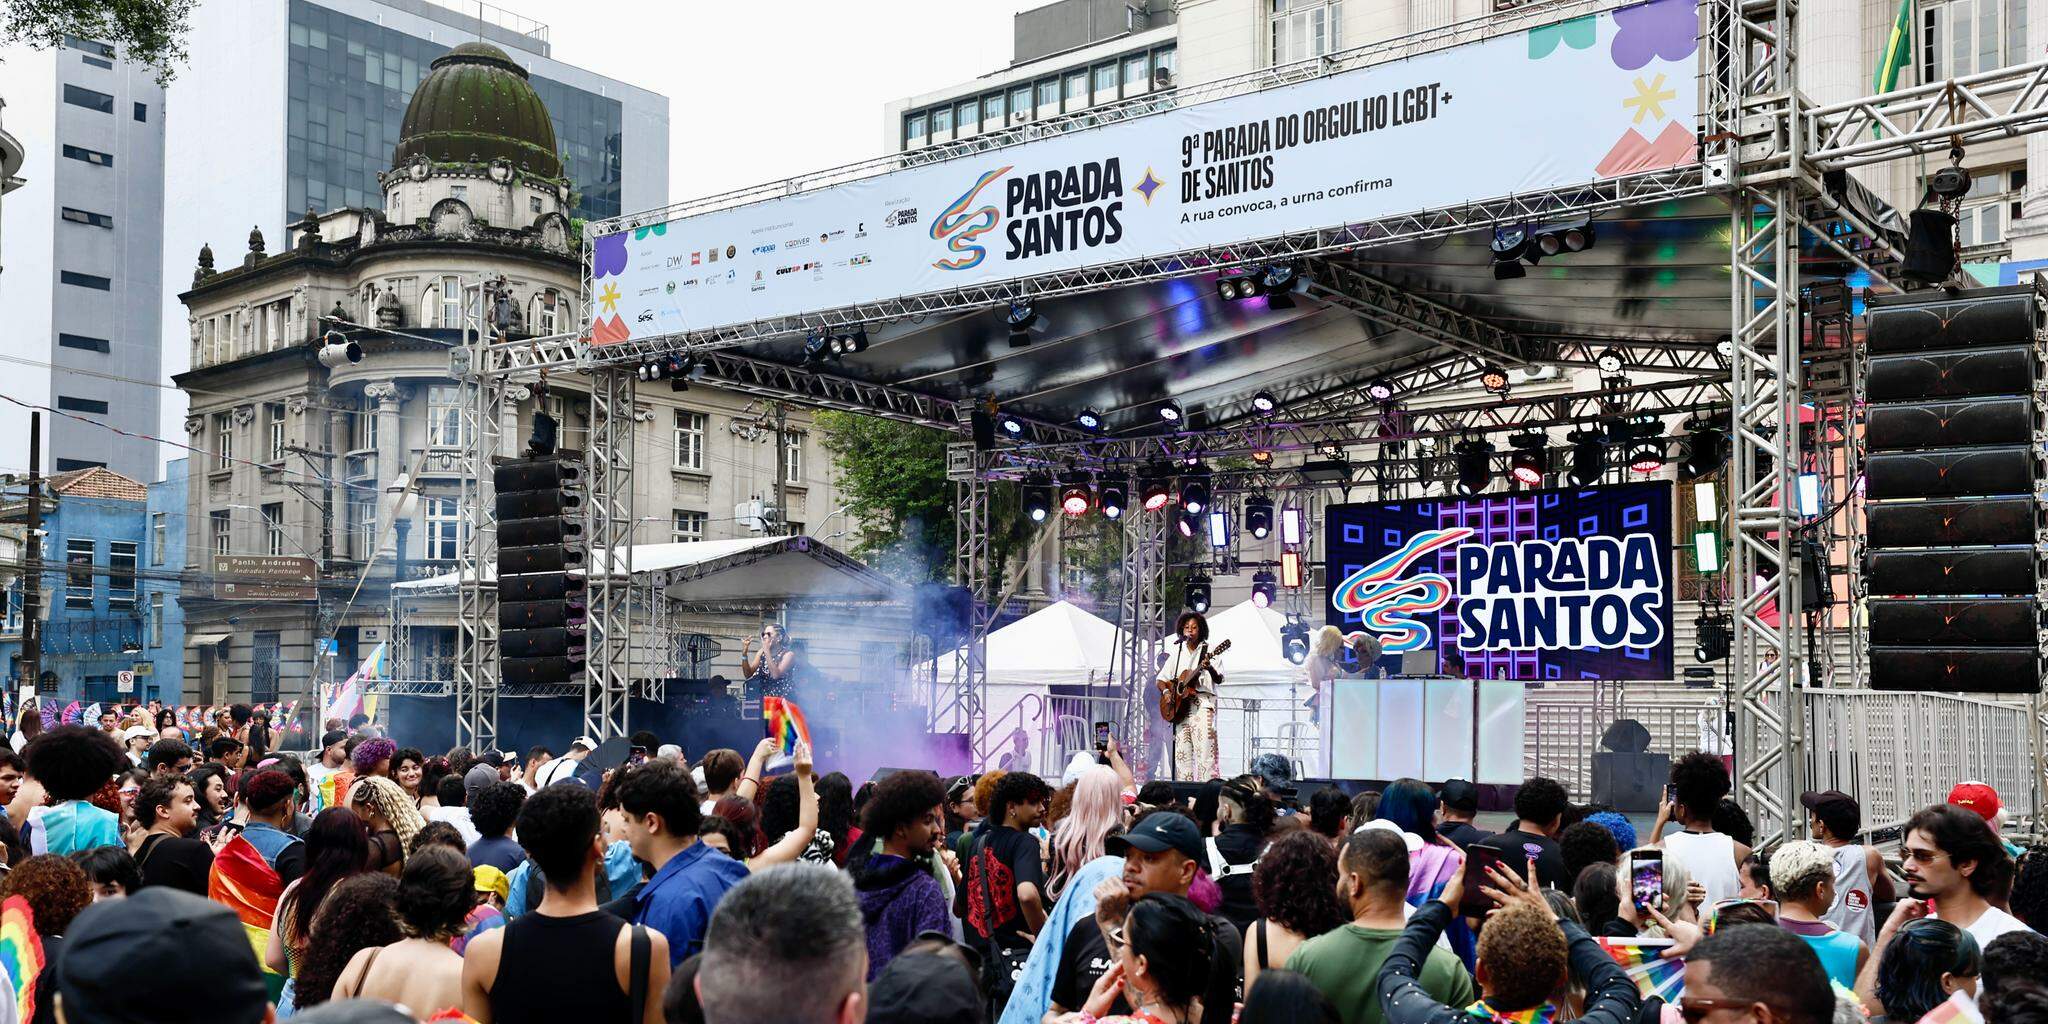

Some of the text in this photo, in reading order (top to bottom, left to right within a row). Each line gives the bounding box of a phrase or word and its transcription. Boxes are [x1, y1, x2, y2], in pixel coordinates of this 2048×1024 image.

[1181, 82, 1453, 168] 9ª PARADA DO ORGULHO LGBT+
[1006, 156, 1123, 218] PARADA
[1180, 177, 1393, 224] A rua convoca, a urna confirma
[1181, 155, 1274, 204] DE SANTOS
[897, 207, 918, 218] PARADA
[897, 215, 918, 226] SANTOS
[1005, 201, 1123, 261] SANTOS
[261, 559, 301, 567] Andradas
[1459, 535, 1661, 596] PARADA
[1459, 592, 1661, 648] SANTOS
